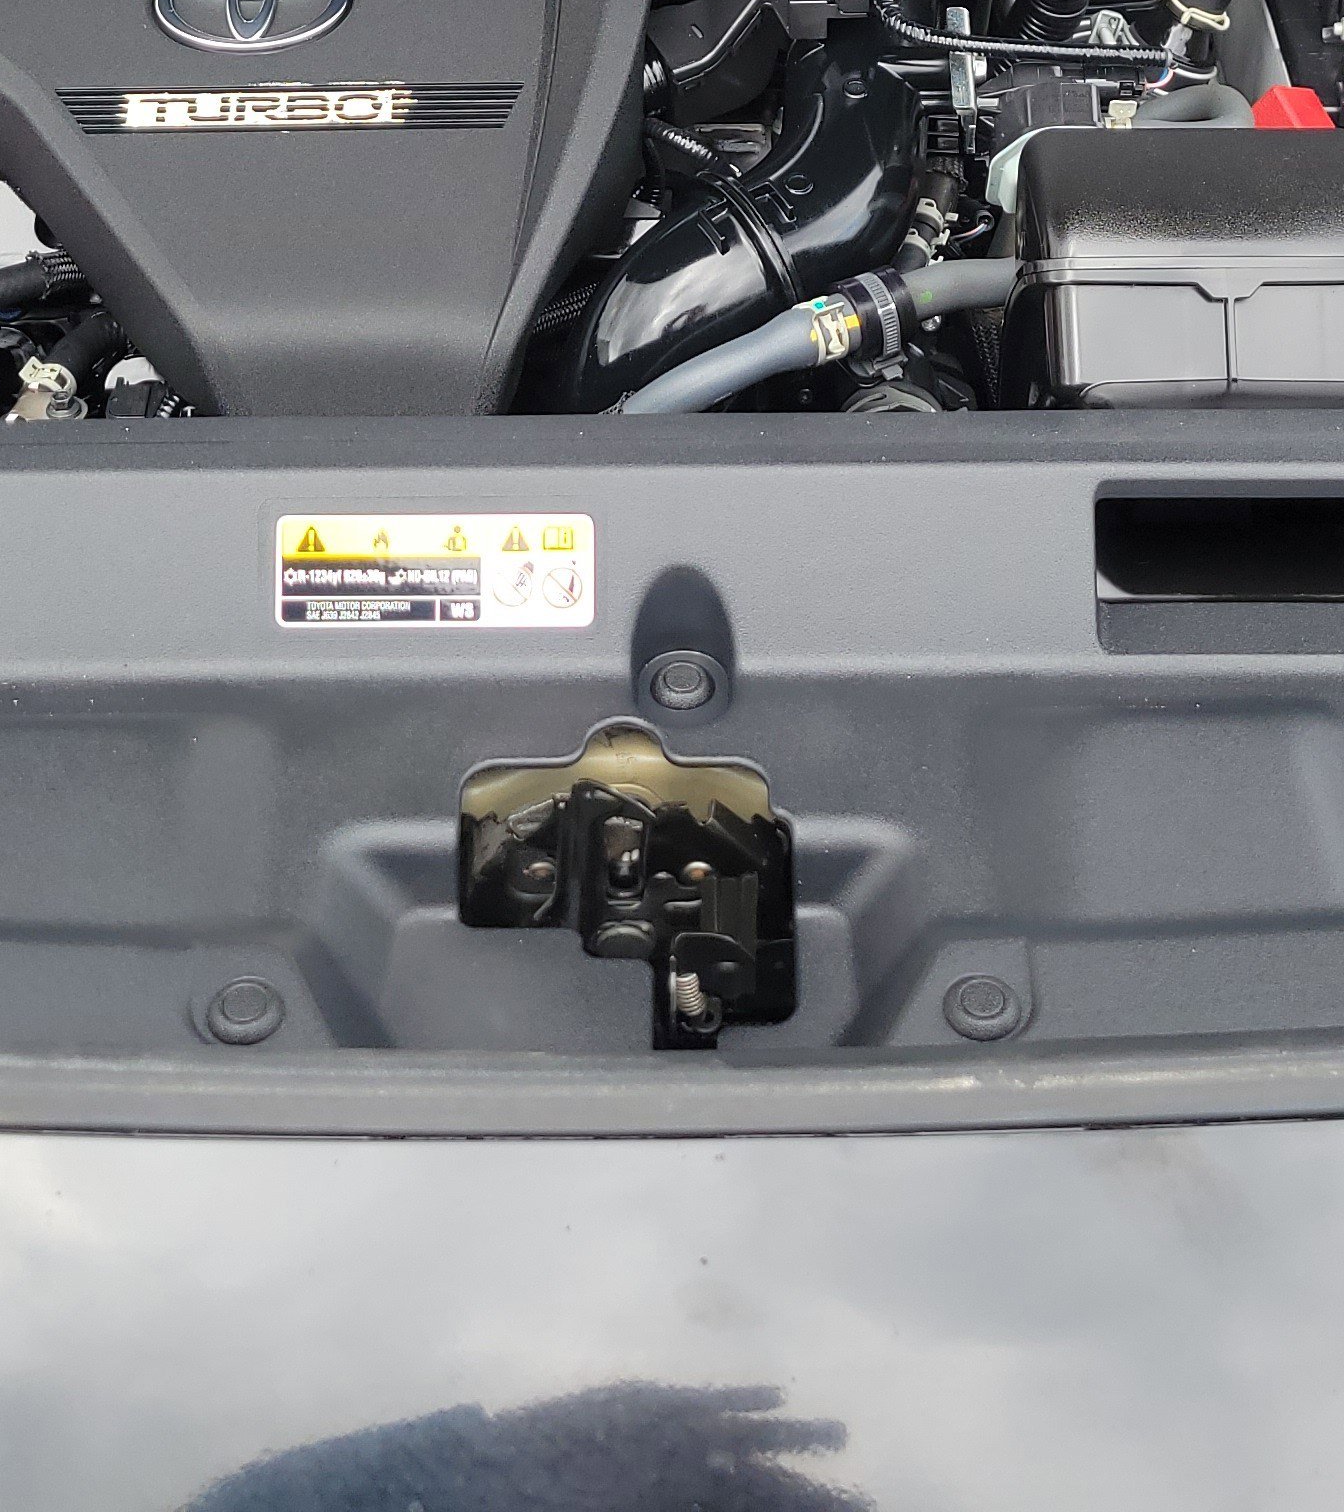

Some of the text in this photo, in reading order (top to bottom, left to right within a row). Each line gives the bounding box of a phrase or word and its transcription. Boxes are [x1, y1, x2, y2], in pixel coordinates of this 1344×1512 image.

[133, 91, 387, 124] TURBO
[306, 601, 411, 611] TOYOTA MOTOR CORPORATION
[449, 602, 474, 619] WS
[306, 611, 321, 620] SAE
